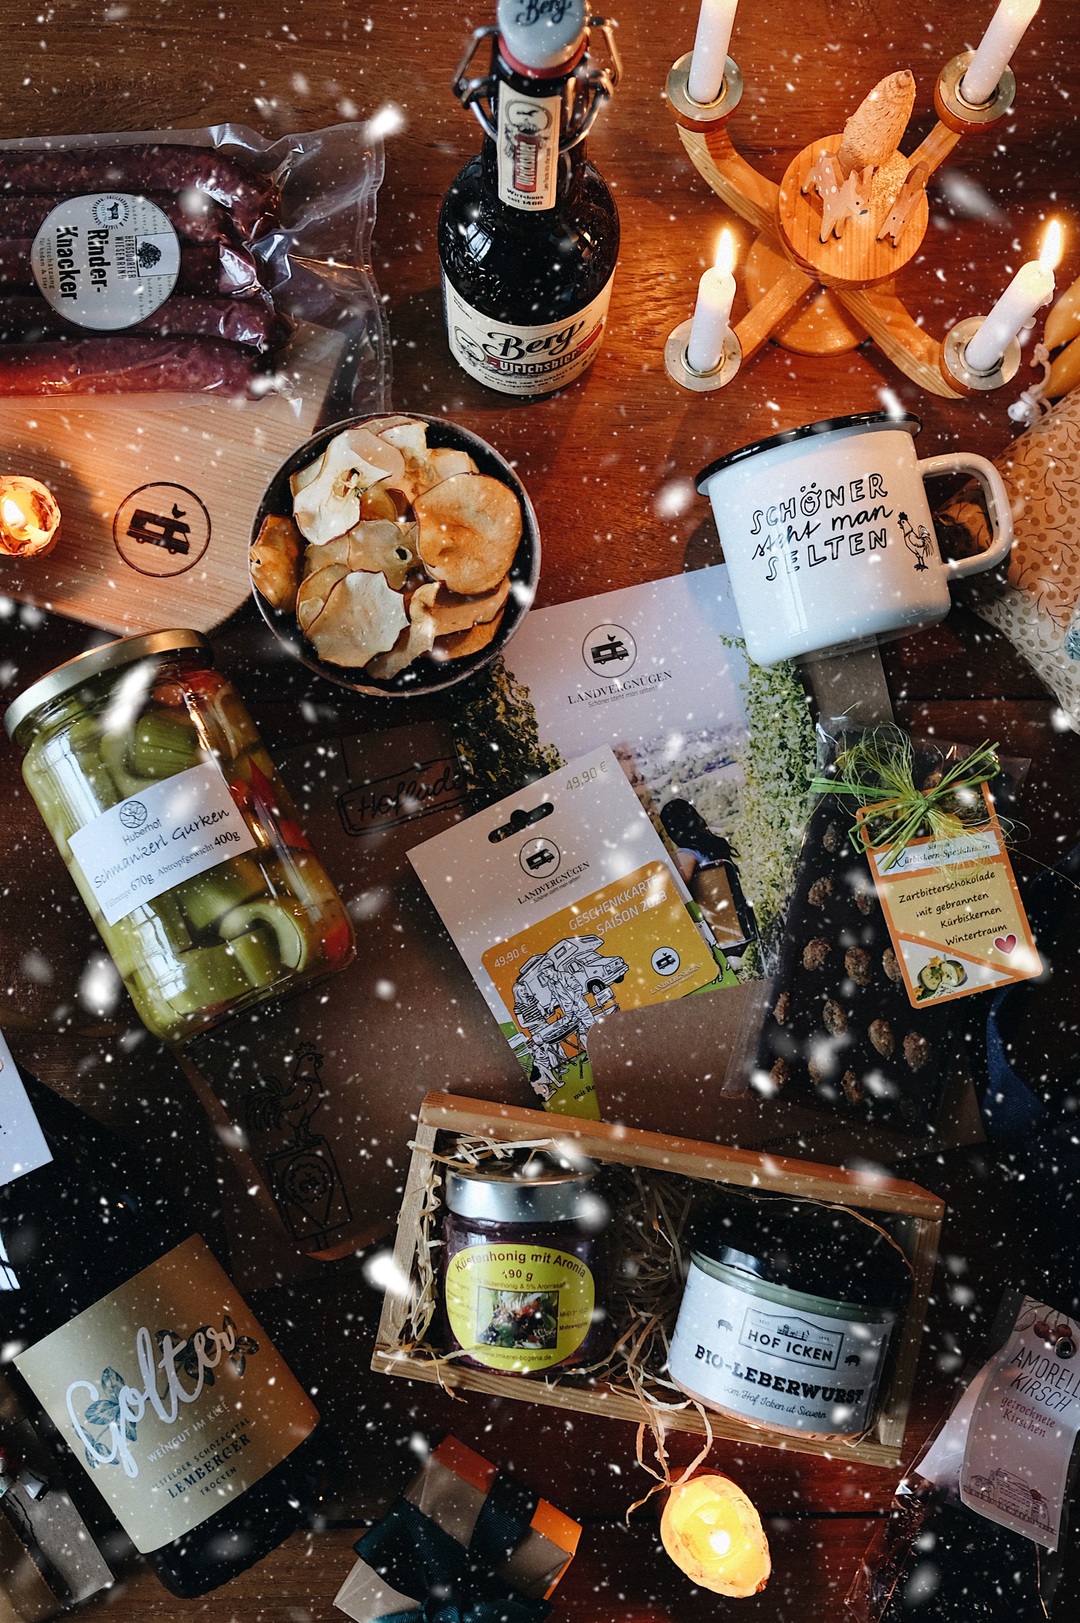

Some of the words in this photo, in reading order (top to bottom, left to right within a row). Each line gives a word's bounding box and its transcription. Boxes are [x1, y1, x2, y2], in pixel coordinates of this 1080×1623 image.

[56, 226, 81, 300] Knacker
[87, 229, 111, 293] Rinder-
[482, 320, 585, 361] Berg
[499, 349, 578, 375] Ulrichsbier
[750, 473, 888, 535] SCHÖNER
[832, 505, 893, 531] man
[765, 528, 887, 581] SELTEN
[567, 670, 673, 704] LANDVERGNÜGEN
[565, 767, 598, 791] 49,90
[600, 761, 609, 773] €
[123, 817, 162, 846] Huberhof
[93, 834, 169, 889] Schmankerl
[172, 809, 229, 841] Gurken
[130, 872, 155, 892] 670g
[157, 843, 215, 876] Abtropfgewicht
[213, 830, 241, 847] 400g
[517, 861, 590, 904] LANDVERGNÜGEN
[899, 871, 996, 904] Zartbitterschokolade
[568, 874, 660, 930] GESCHENKKARTE
[596, 904, 640, 936] SAISON
[640, 890, 668, 912] 2023
[916, 906, 933, 917] mit
[936, 892, 989, 915] gebrannten
[940, 907, 1002, 929] Kürbiskernen
[945, 924, 1008, 946] Wintertraum
[494, 948, 521, 969] 49,90
[521, 944, 528, 954] €
[573, 1089, 585, 1100] mit
[455, 1251, 526, 1273] Küstenhonig
[531, 1253, 551, 1264] mit
[553, 1255, 587, 1278] Aronia
[502, 1269, 522, 1280] 190
[526, 1272, 534, 1282] g
[748, 1329, 781, 1348] HOF
[786, 1342, 833, 1362] ICKEN
[694, 1344, 864, 1404] BIO-LEBERWURST
[1010, 1346, 1080, 1400] AMORELL
[741, 1389, 760, 1406] Hof
[760, 1397, 785, 1411] Icken
[1010, 1372, 1072, 1412] KIRSCH
[1001, 1397, 1056, 1428] getrocknete
[1002, 1408, 1046, 1438] Kirschen
[147, 1428, 191, 1463] WEINGUT
[192, 1419, 207, 1432] IM
[206, 1401, 229, 1422] KLEE
[194, 1418, 250, 1462] SCHOZACHTAL
[167, 1434, 251, 1498] LEMBERGER
[200, 1466, 237, 1496] TROCKEN
